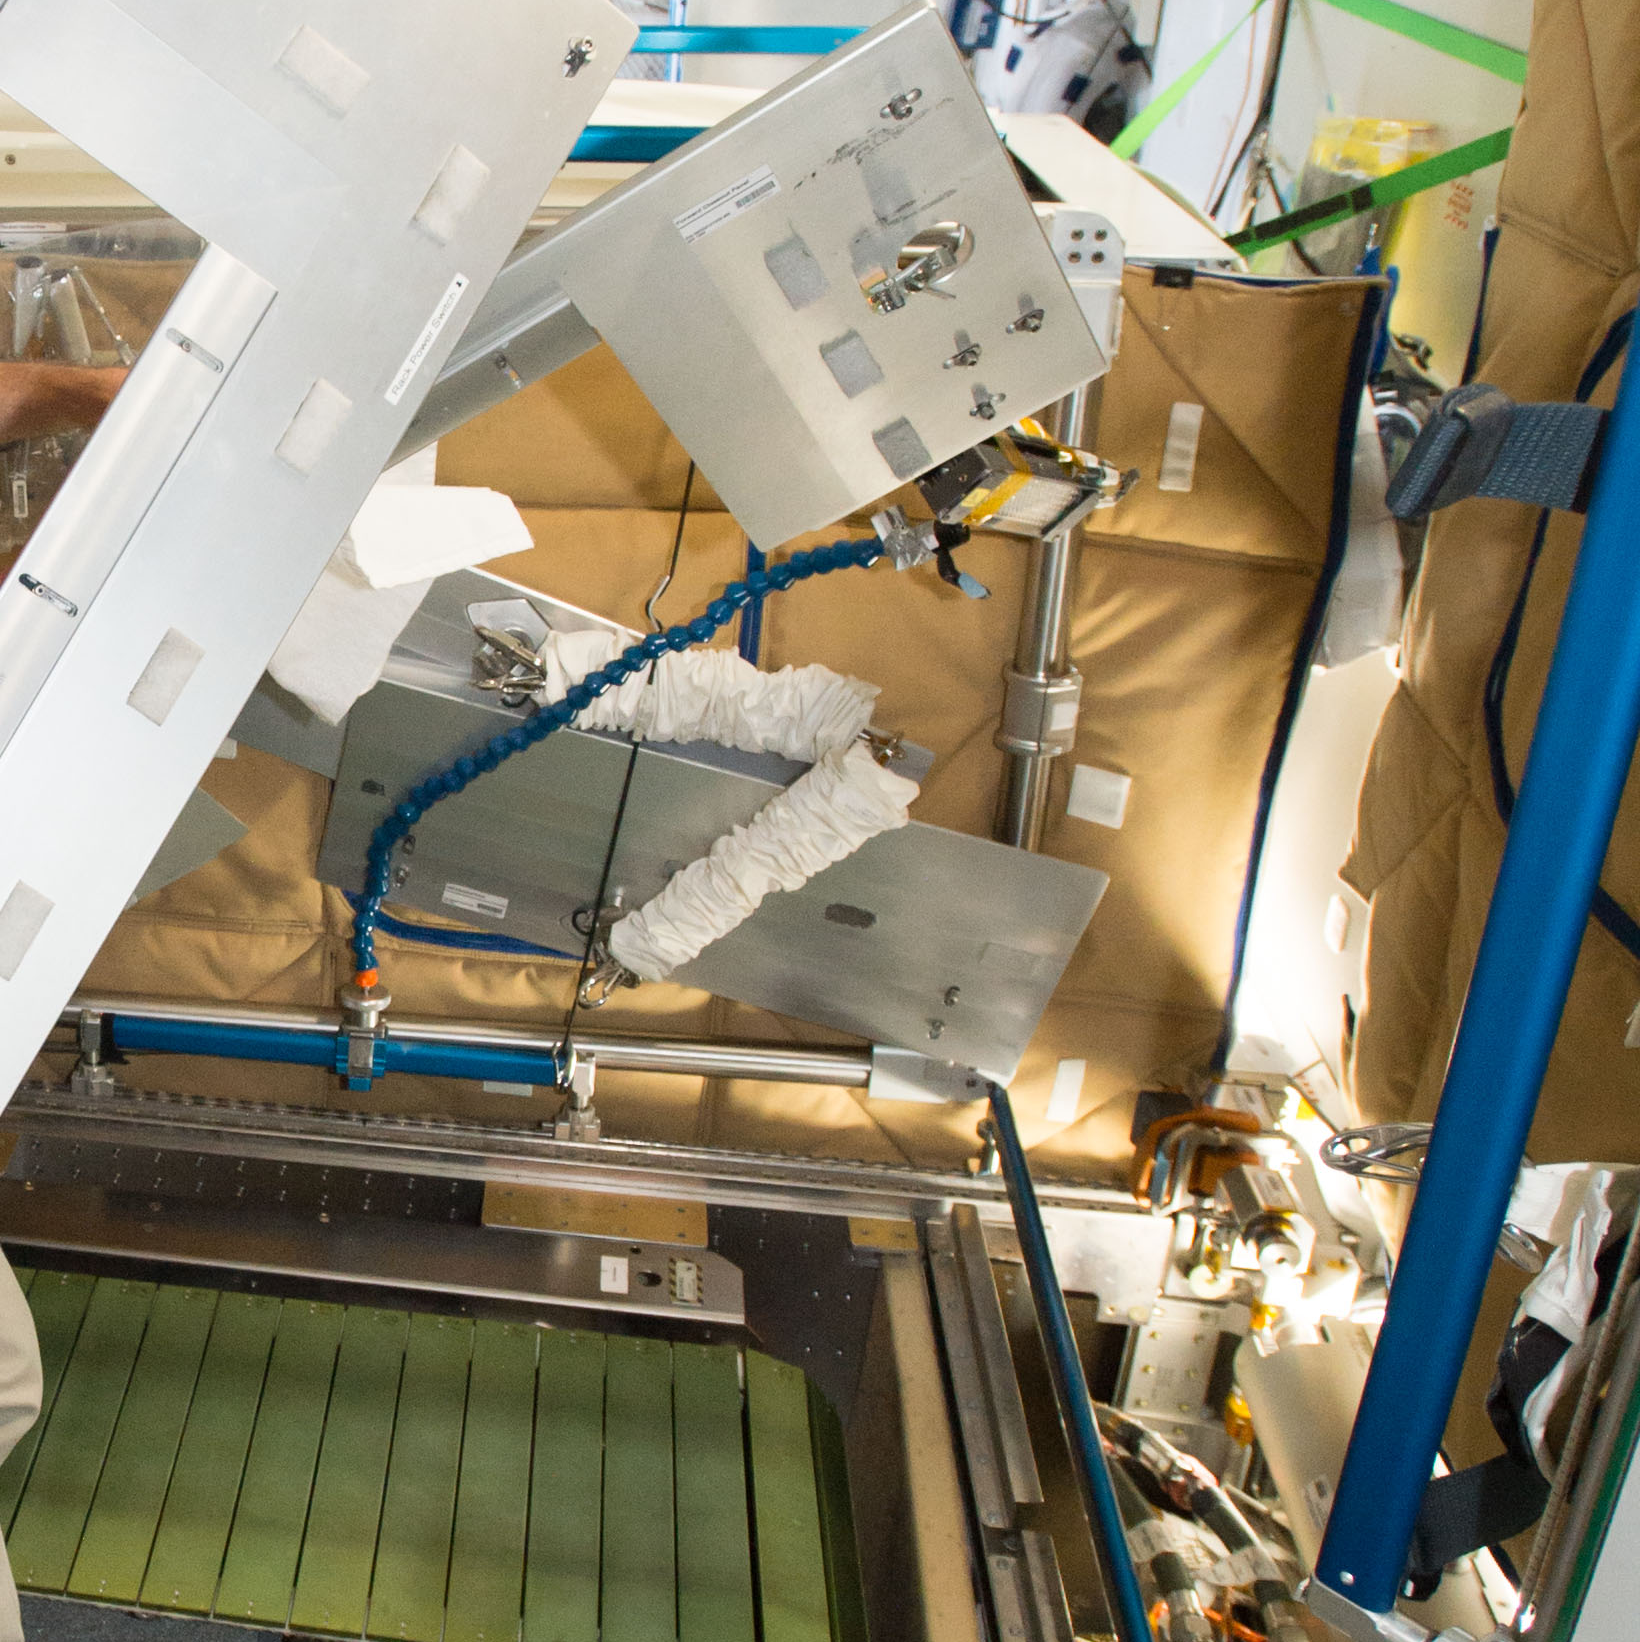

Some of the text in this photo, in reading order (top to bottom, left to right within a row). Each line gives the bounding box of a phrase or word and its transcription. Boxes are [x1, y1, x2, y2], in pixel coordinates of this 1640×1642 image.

[391, 291, 458, 397] Rack Power Switch
